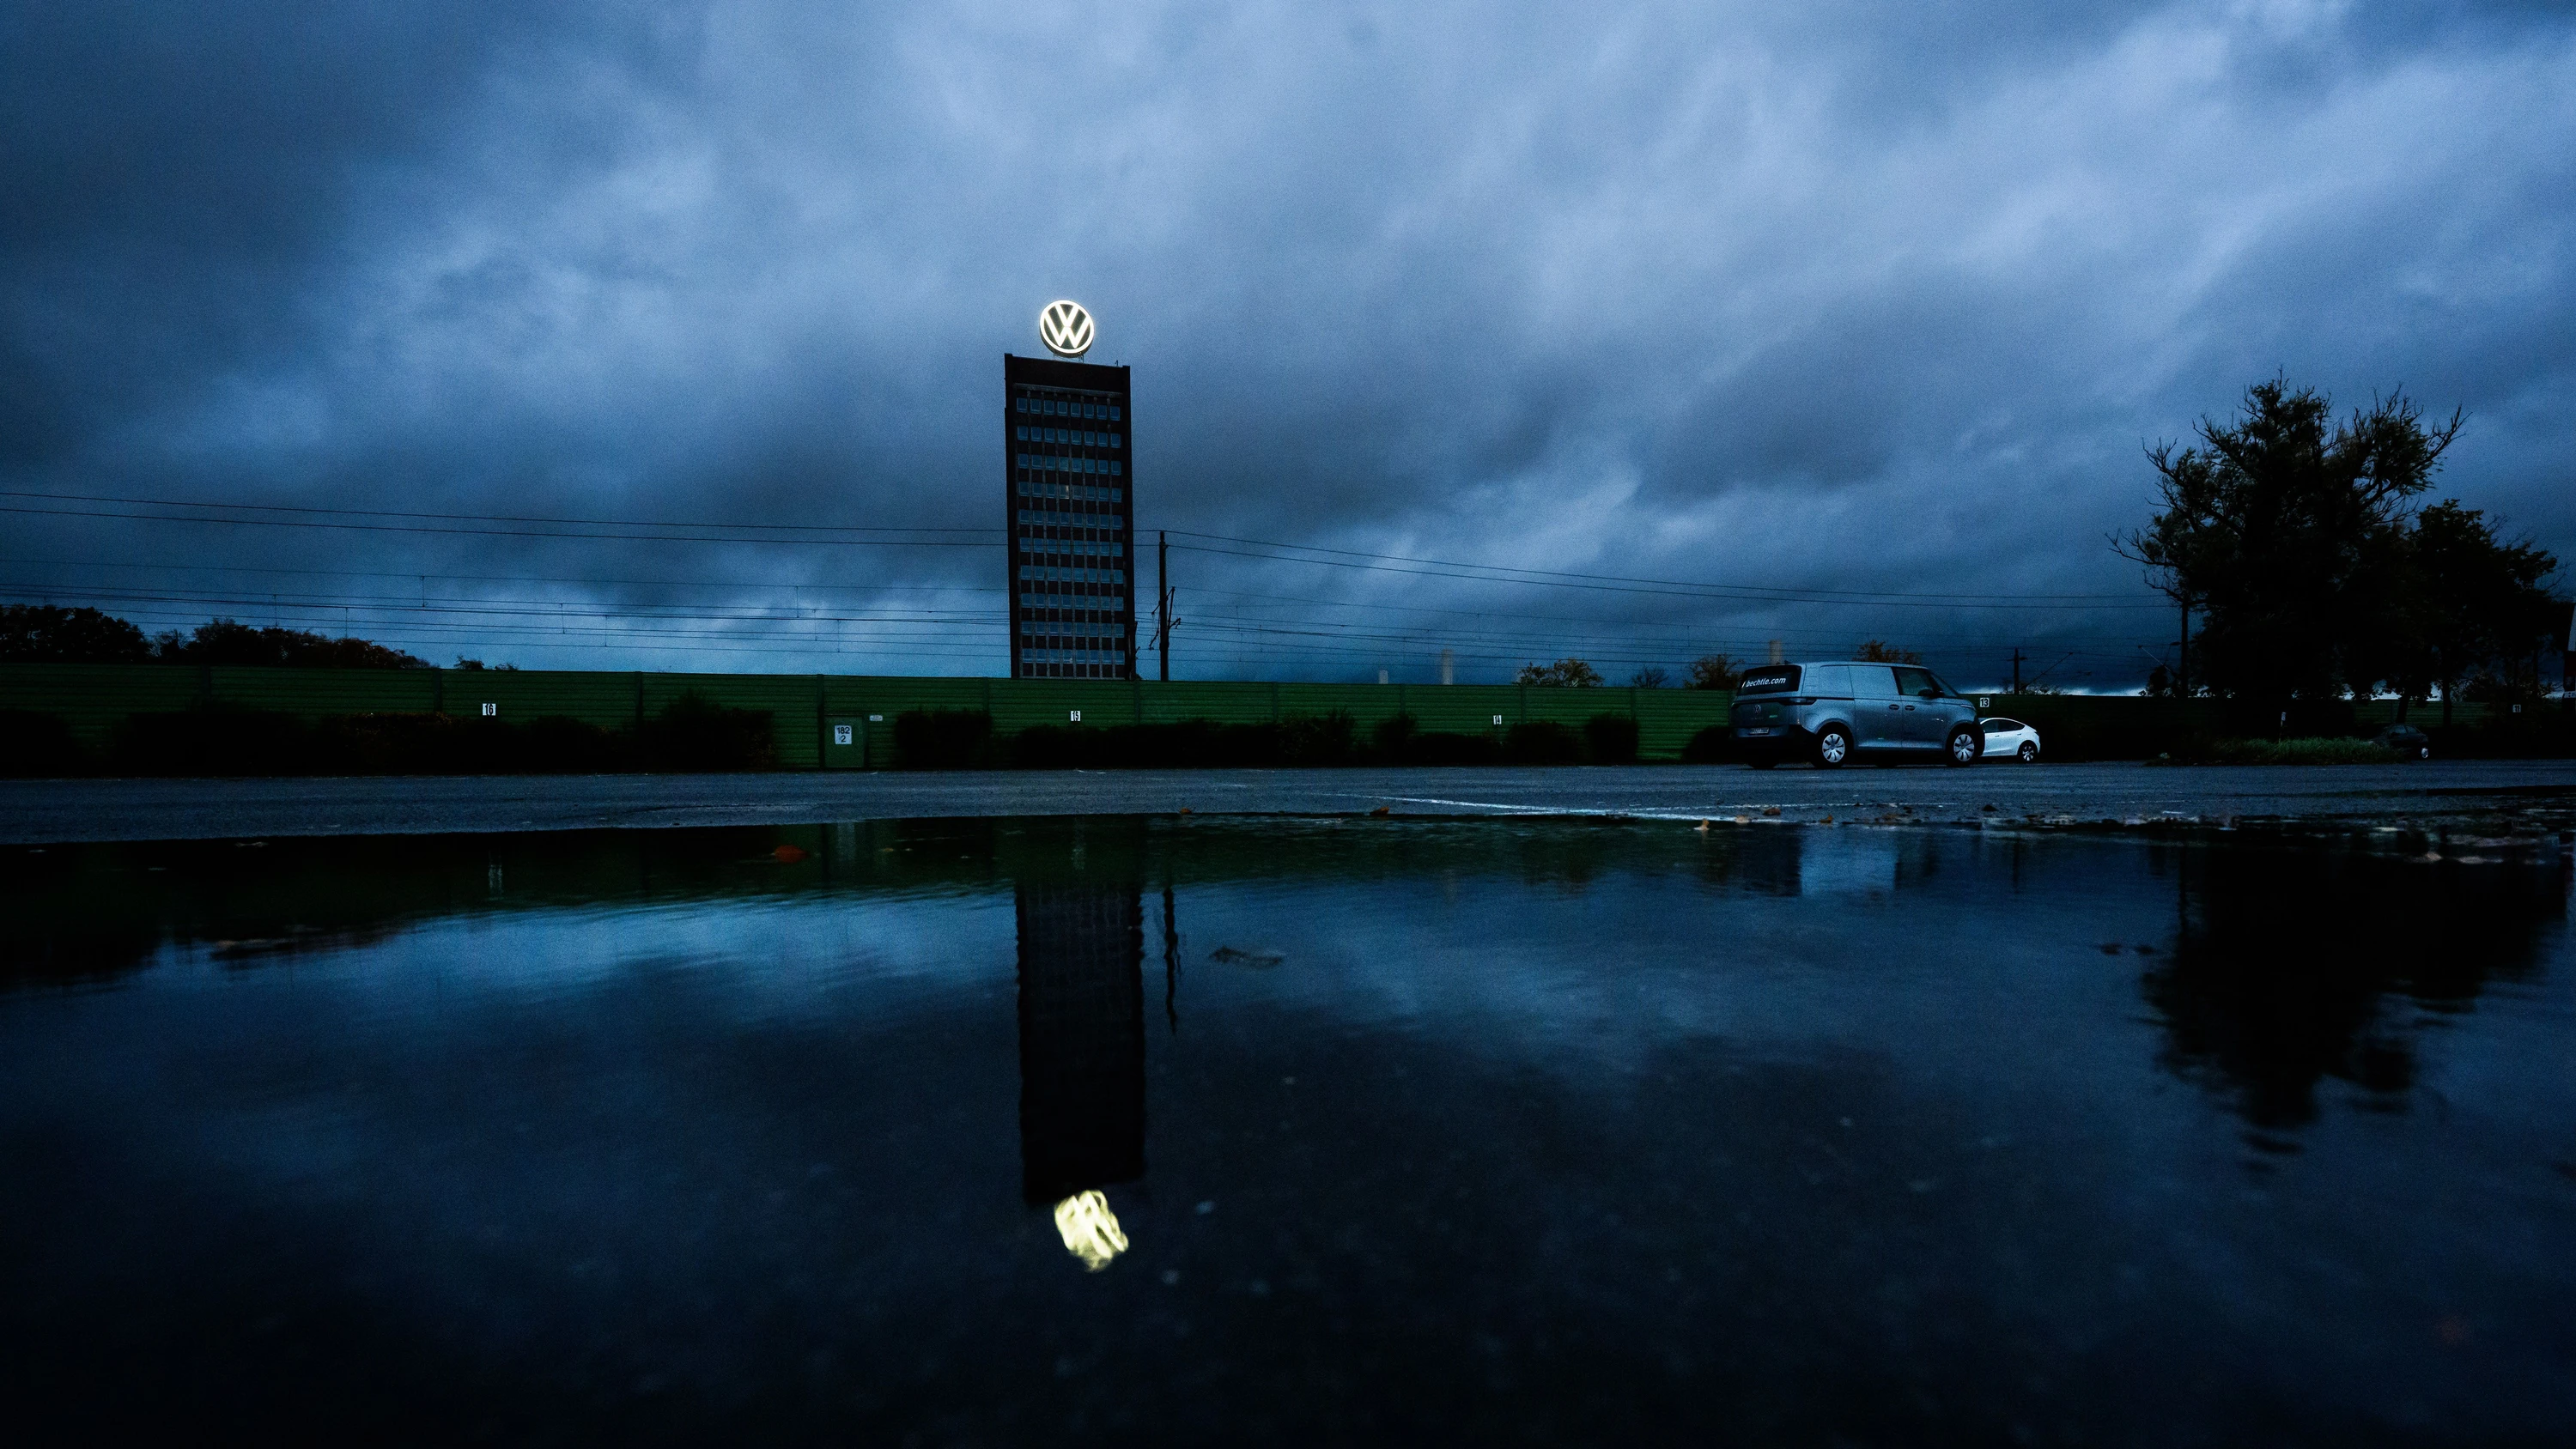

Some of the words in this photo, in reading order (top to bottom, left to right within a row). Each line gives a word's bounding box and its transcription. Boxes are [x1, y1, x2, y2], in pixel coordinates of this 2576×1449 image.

[1041, 300, 1093, 350] VW
[1745, 677, 1787, 688] bechtle.com
[1981, 698, 1989, 706] 13
[484, 703, 494, 715] 16
